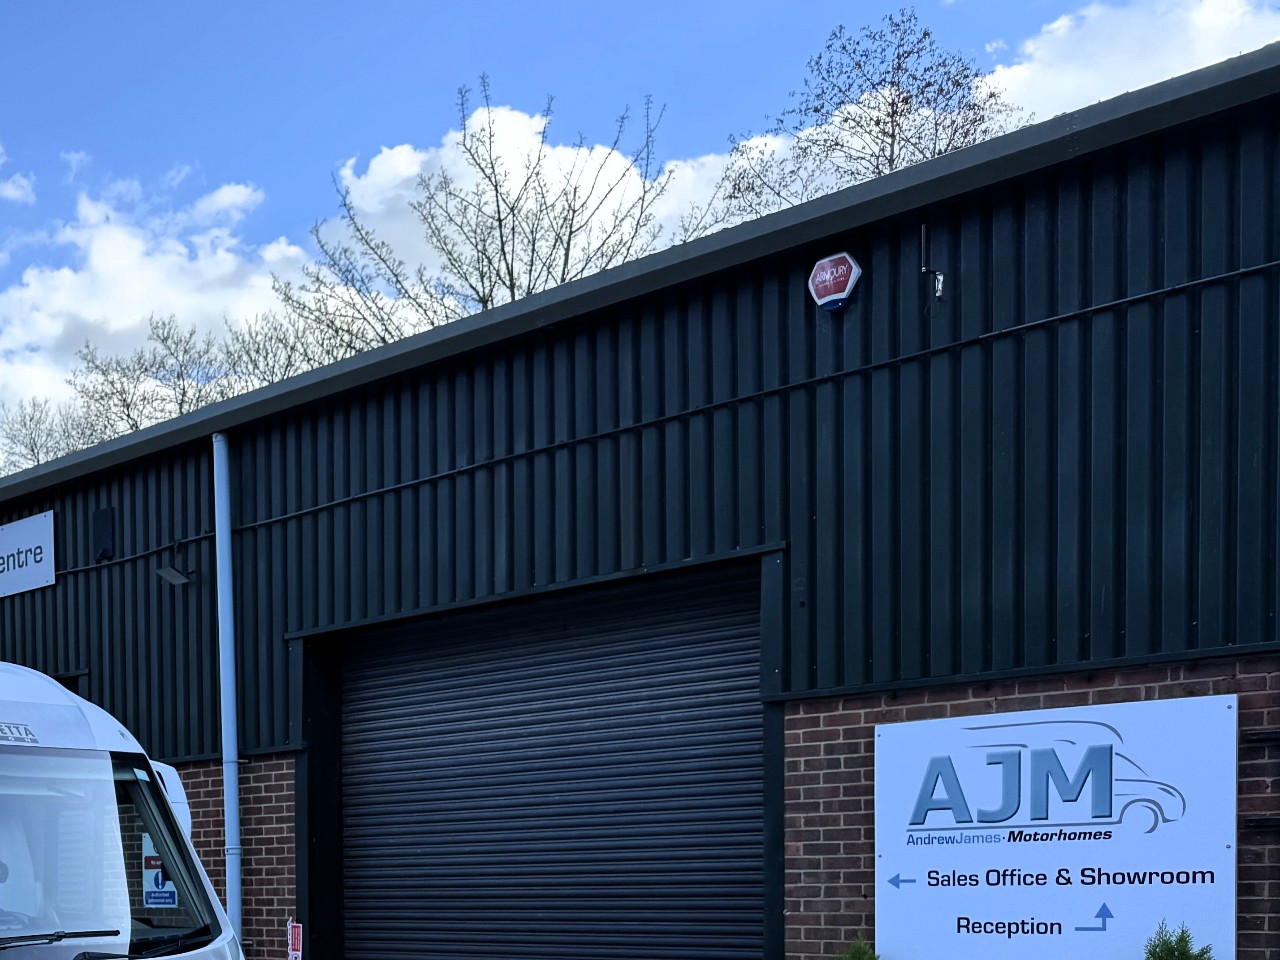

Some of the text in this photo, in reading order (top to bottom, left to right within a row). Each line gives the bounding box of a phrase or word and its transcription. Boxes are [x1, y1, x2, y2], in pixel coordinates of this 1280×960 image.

[908, 743, 1113, 826] AJM
[927, 867, 1215, 887] Sales Office & Showroom
[956, 916, 1062, 939] Reception
